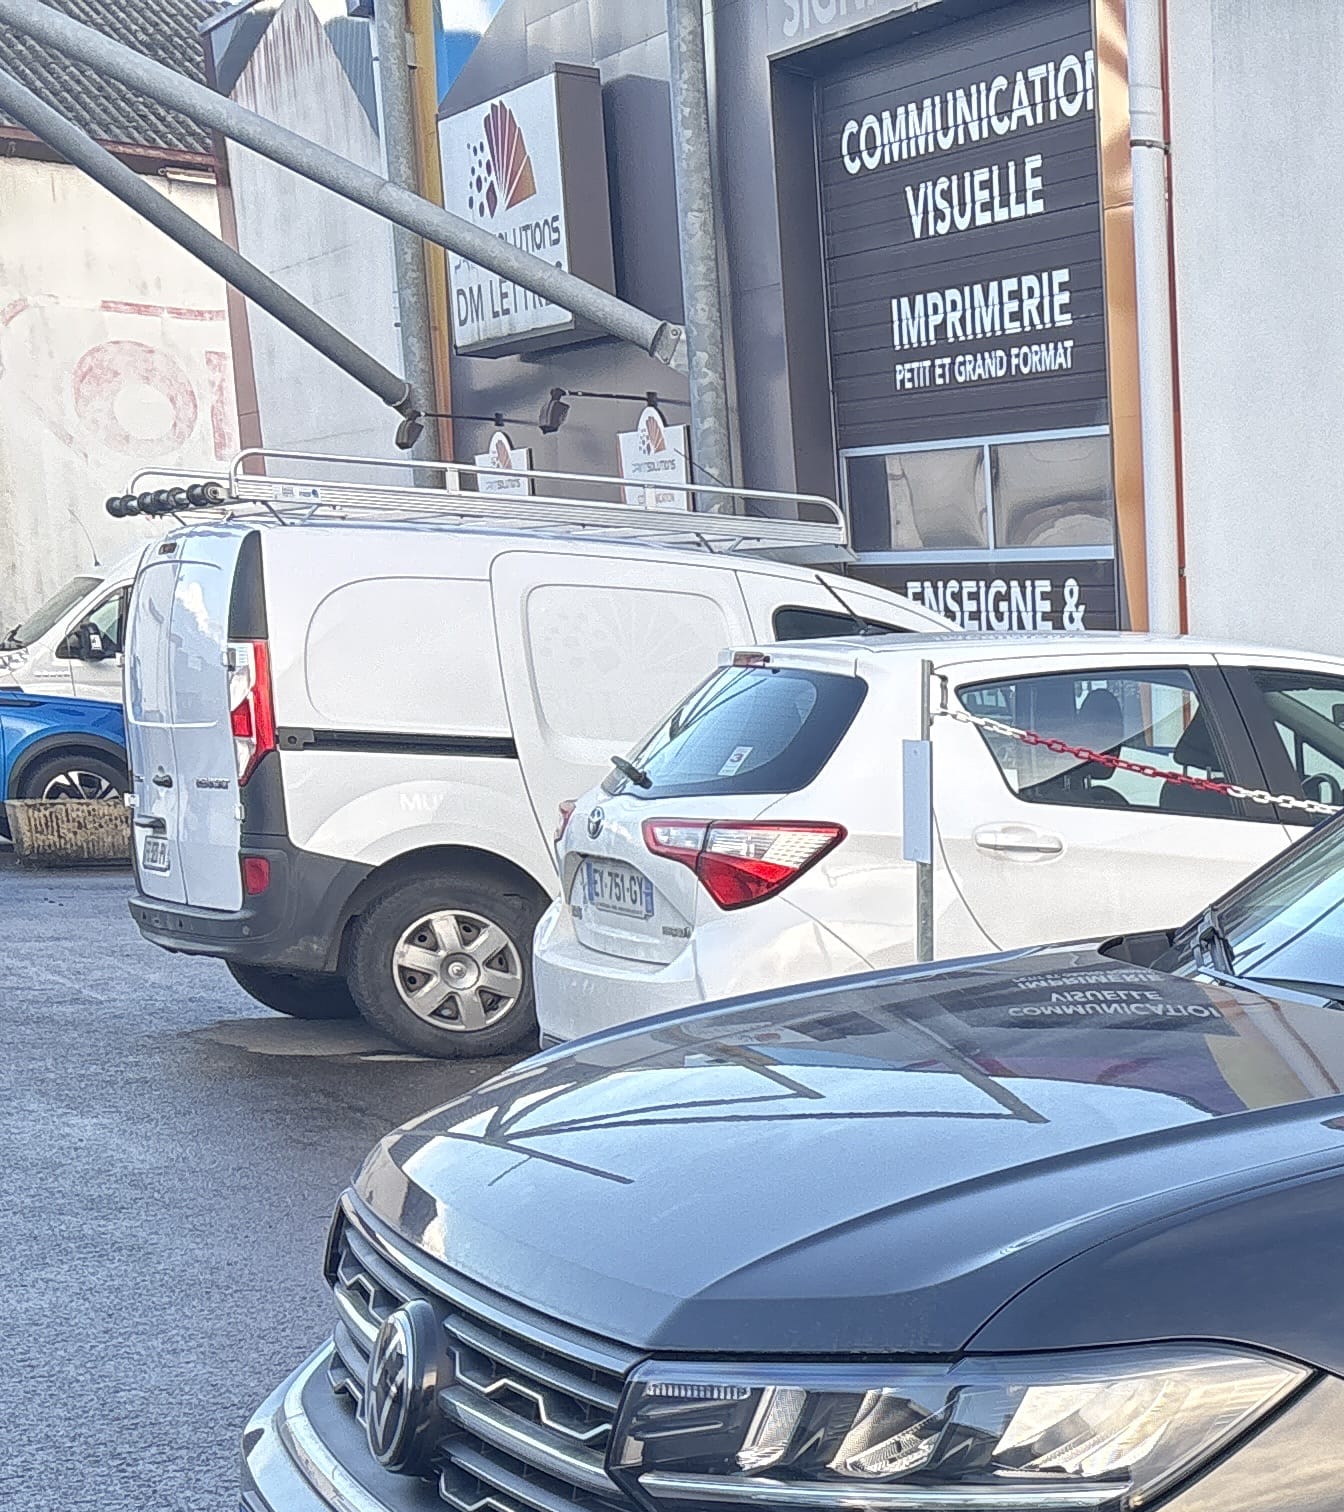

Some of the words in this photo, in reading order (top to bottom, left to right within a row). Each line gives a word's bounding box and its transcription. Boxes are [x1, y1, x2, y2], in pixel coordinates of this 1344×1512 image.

[905, 153, 1045, 239] VISUELLE
[456, 283, 485, 327] DM
[891, 268, 1073, 350] IMPRIMERIE
[895, 360, 932, 390] PETIT
[934, 357, 952, 385] ET
[954, 349, 1008, 383] GRAND
[1011, 339, 1074, 376] FORMAT
[1062, 577, 1086, 632] &
